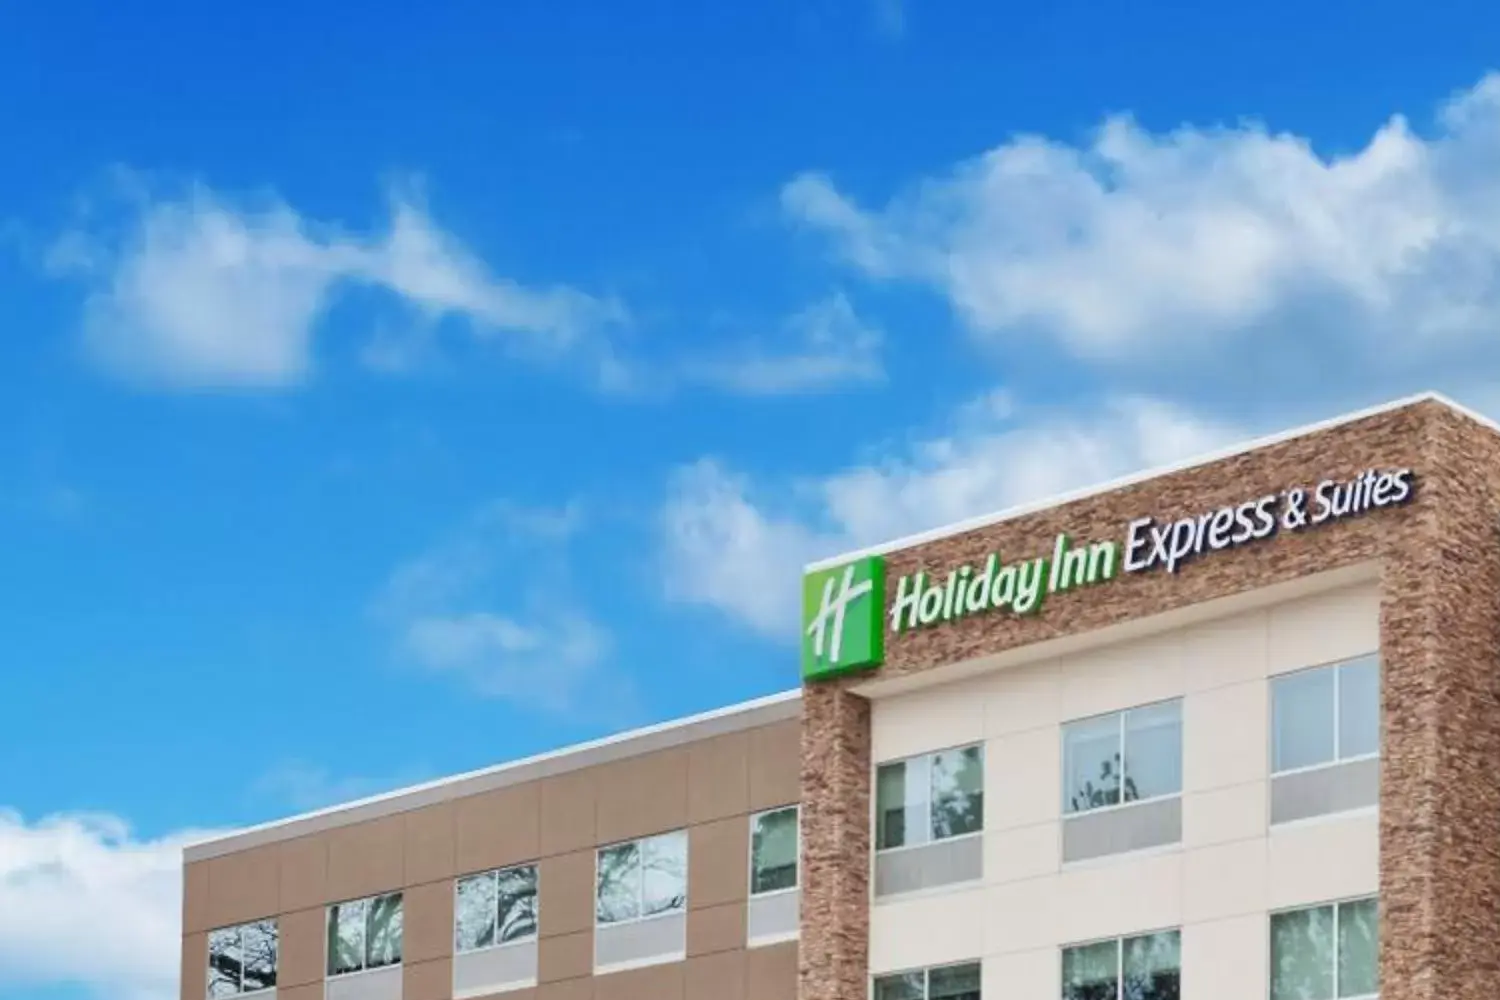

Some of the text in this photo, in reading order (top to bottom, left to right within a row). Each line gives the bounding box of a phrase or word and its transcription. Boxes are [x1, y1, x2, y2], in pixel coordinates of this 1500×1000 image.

[805, 564, 873, 662] H
[890, 467, 1411, 631] Holiday Inn Express & Suites
